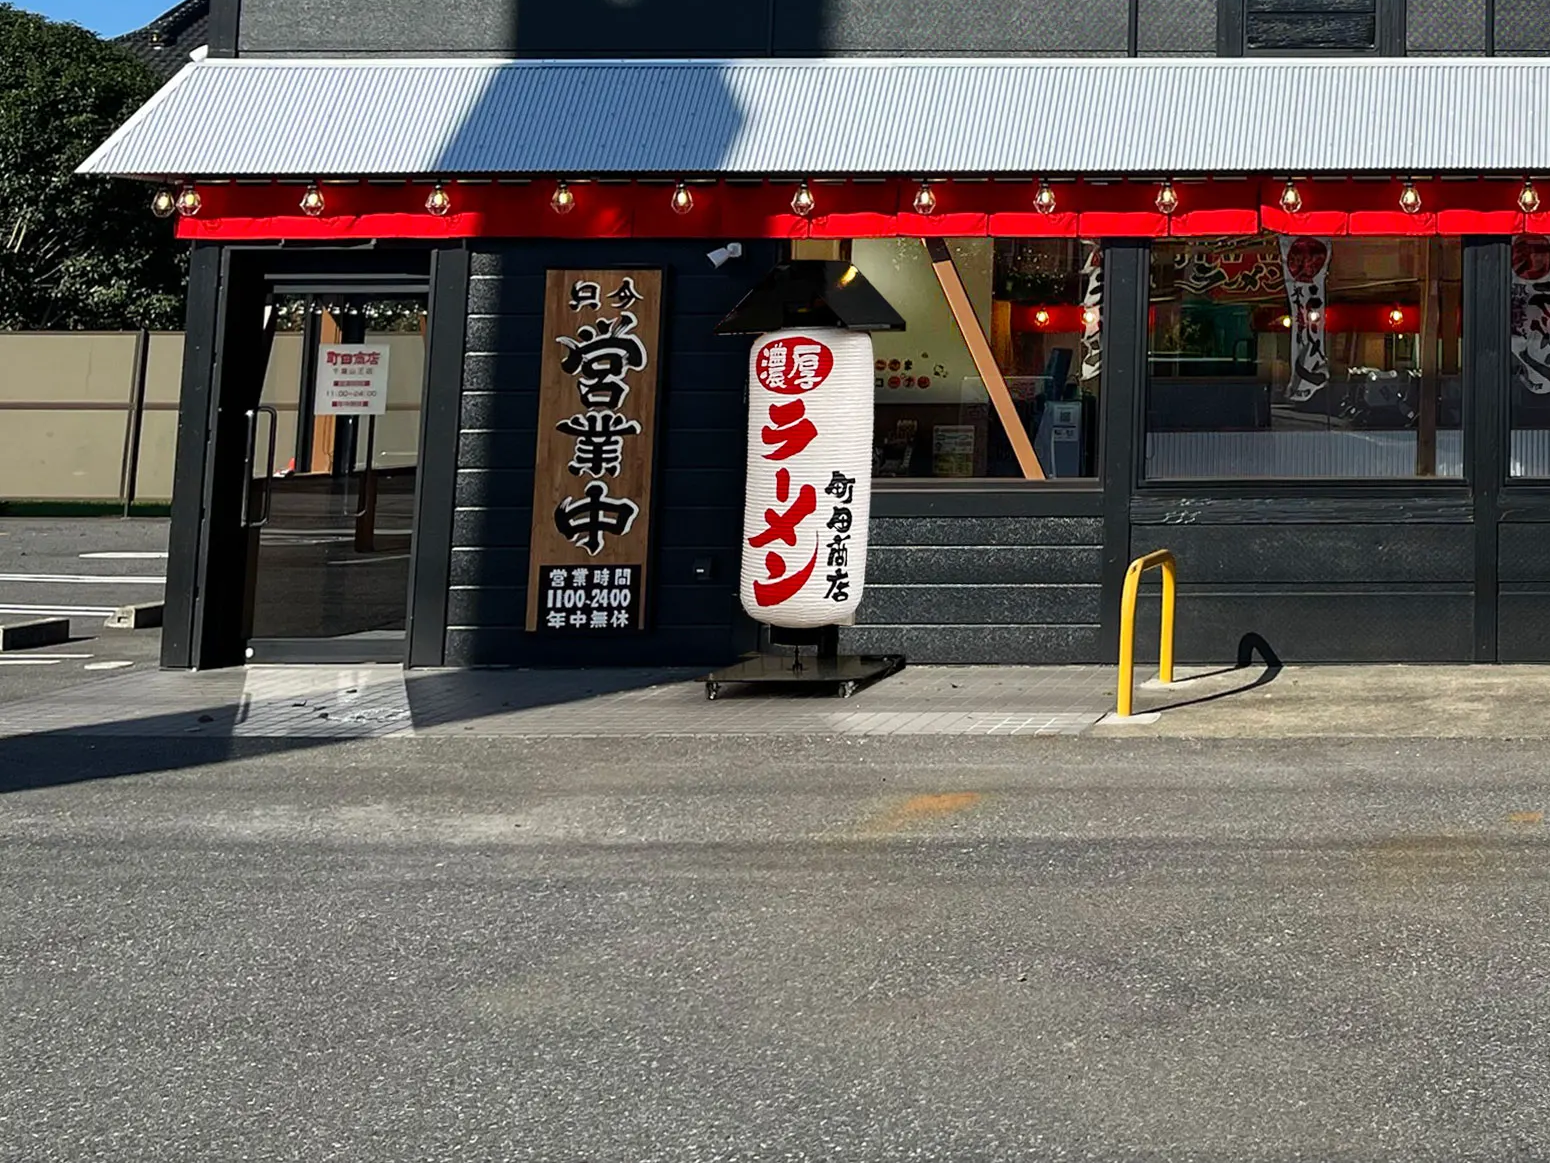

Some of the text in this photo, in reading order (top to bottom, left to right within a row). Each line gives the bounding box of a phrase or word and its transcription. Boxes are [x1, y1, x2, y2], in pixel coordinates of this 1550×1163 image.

[326, 350, 381, 366] 町田商店
[760, 342, 822, 389] 濃厚
[554, 311, 647, 556] 営業中
[747, 398, 818, 607] ラーメン
[824, 471, 856, 602] 町田商店
[549, 567, 631, 587] 営業時間
[546, 610, 629, 629] 年中無休
